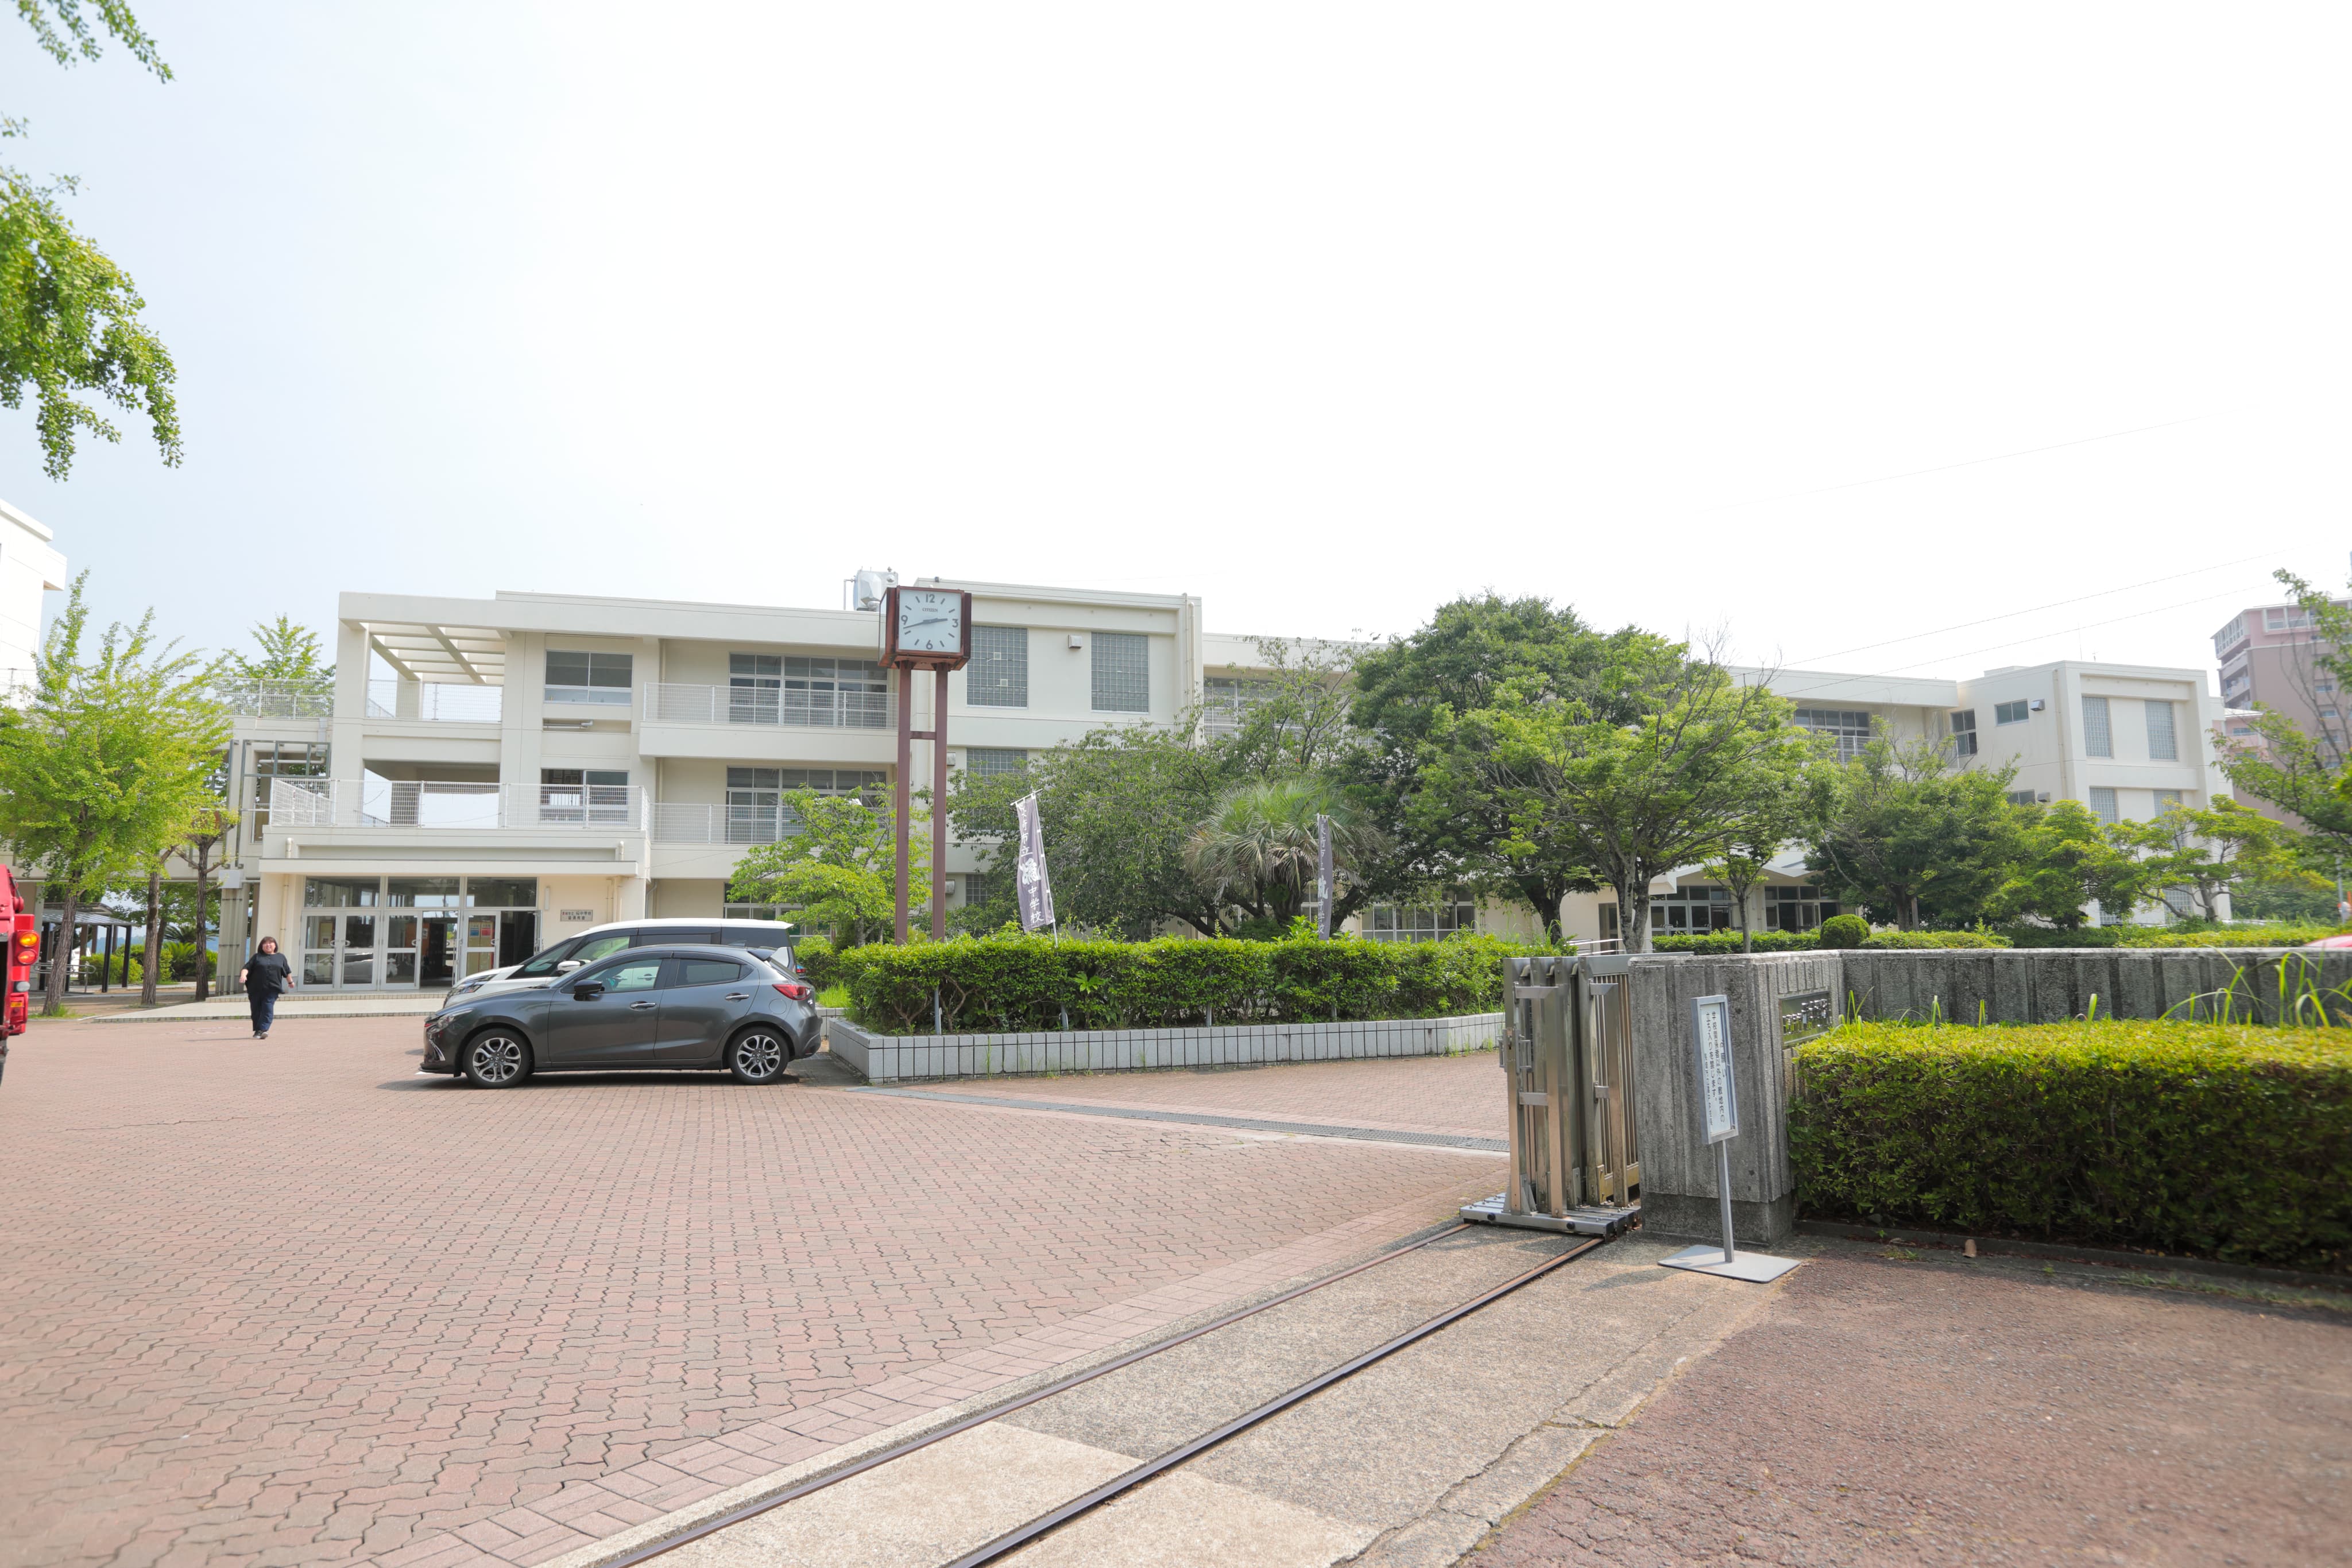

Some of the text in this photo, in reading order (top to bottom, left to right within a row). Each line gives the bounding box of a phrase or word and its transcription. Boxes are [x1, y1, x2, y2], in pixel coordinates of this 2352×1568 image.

[926, 593, 935, 603] 12
[901, 615, 908, 625] 9
[952, 618, 959, 628] 3
[926, 640, 933, 650] 6
